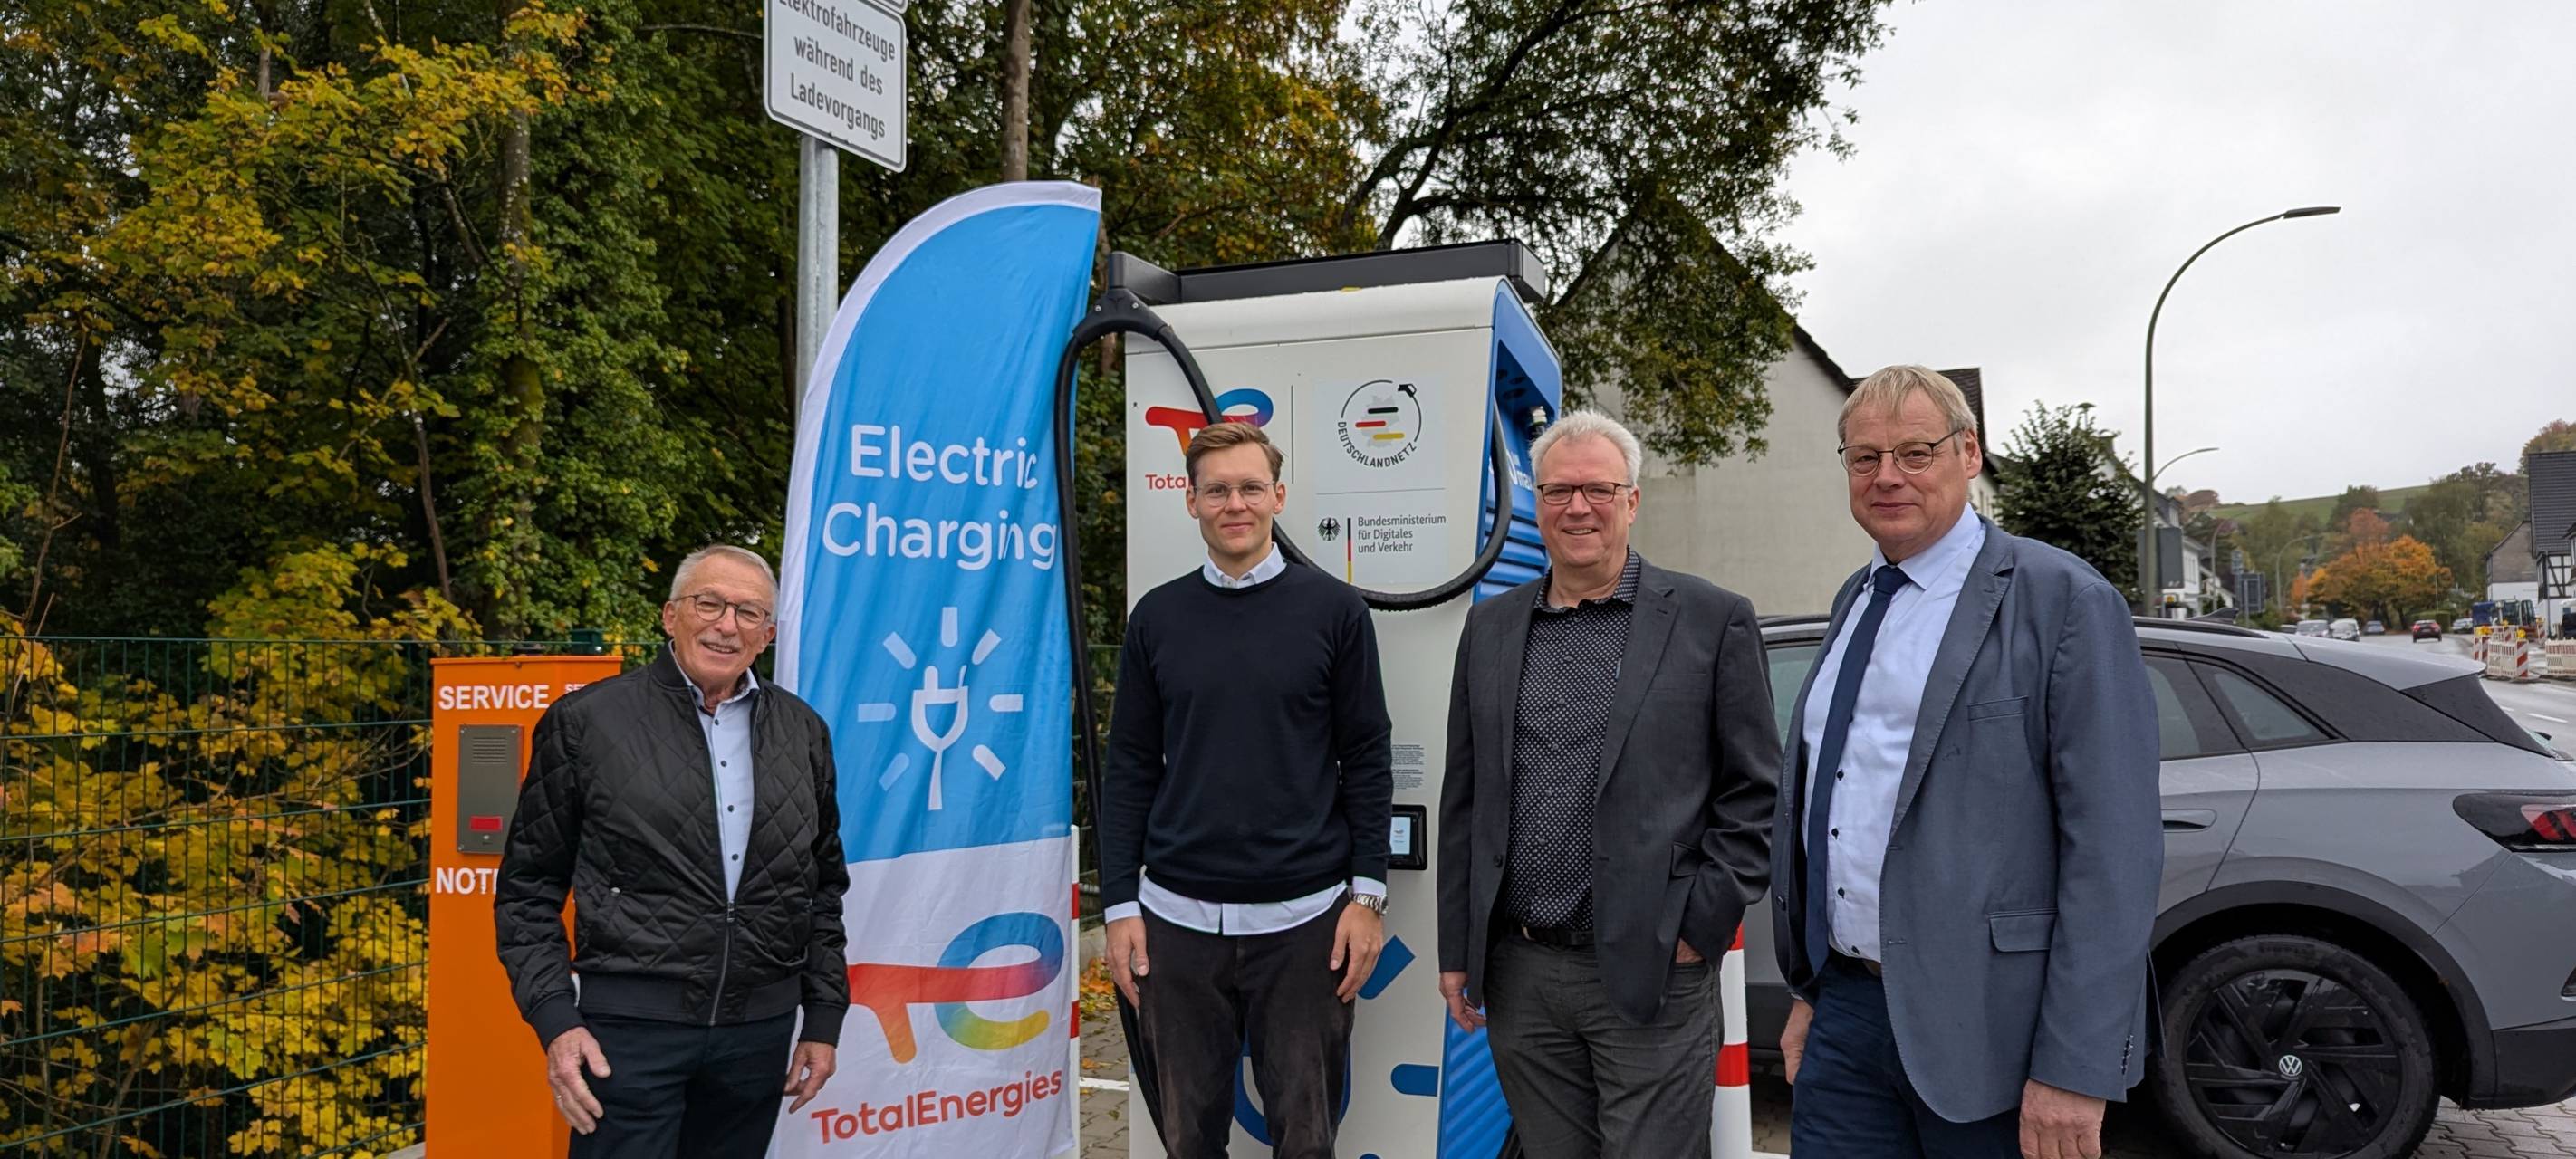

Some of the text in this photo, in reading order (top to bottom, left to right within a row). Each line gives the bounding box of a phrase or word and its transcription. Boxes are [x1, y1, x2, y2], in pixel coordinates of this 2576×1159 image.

[793, 36, 883, 96] während des
[791, 72, 886, 141] Ladevorgangs
[851, 424, 1038, 489] Electric
[1338, 421, 1417, 468] DEUTSCHLANDNETZ
[822, 502, 1057, 570] Charging
[1358, 513, 1447, 527] Bundesministerium
[1358, 529, 1414, 541] für Digitales
[1358, 541, 1414, 553] und Verkehr
[438, 685, 550, 710] SERVICE
[436, 867, 499, 895] NOT
[811, 1070, 1062, 1145] TotalEnergies
